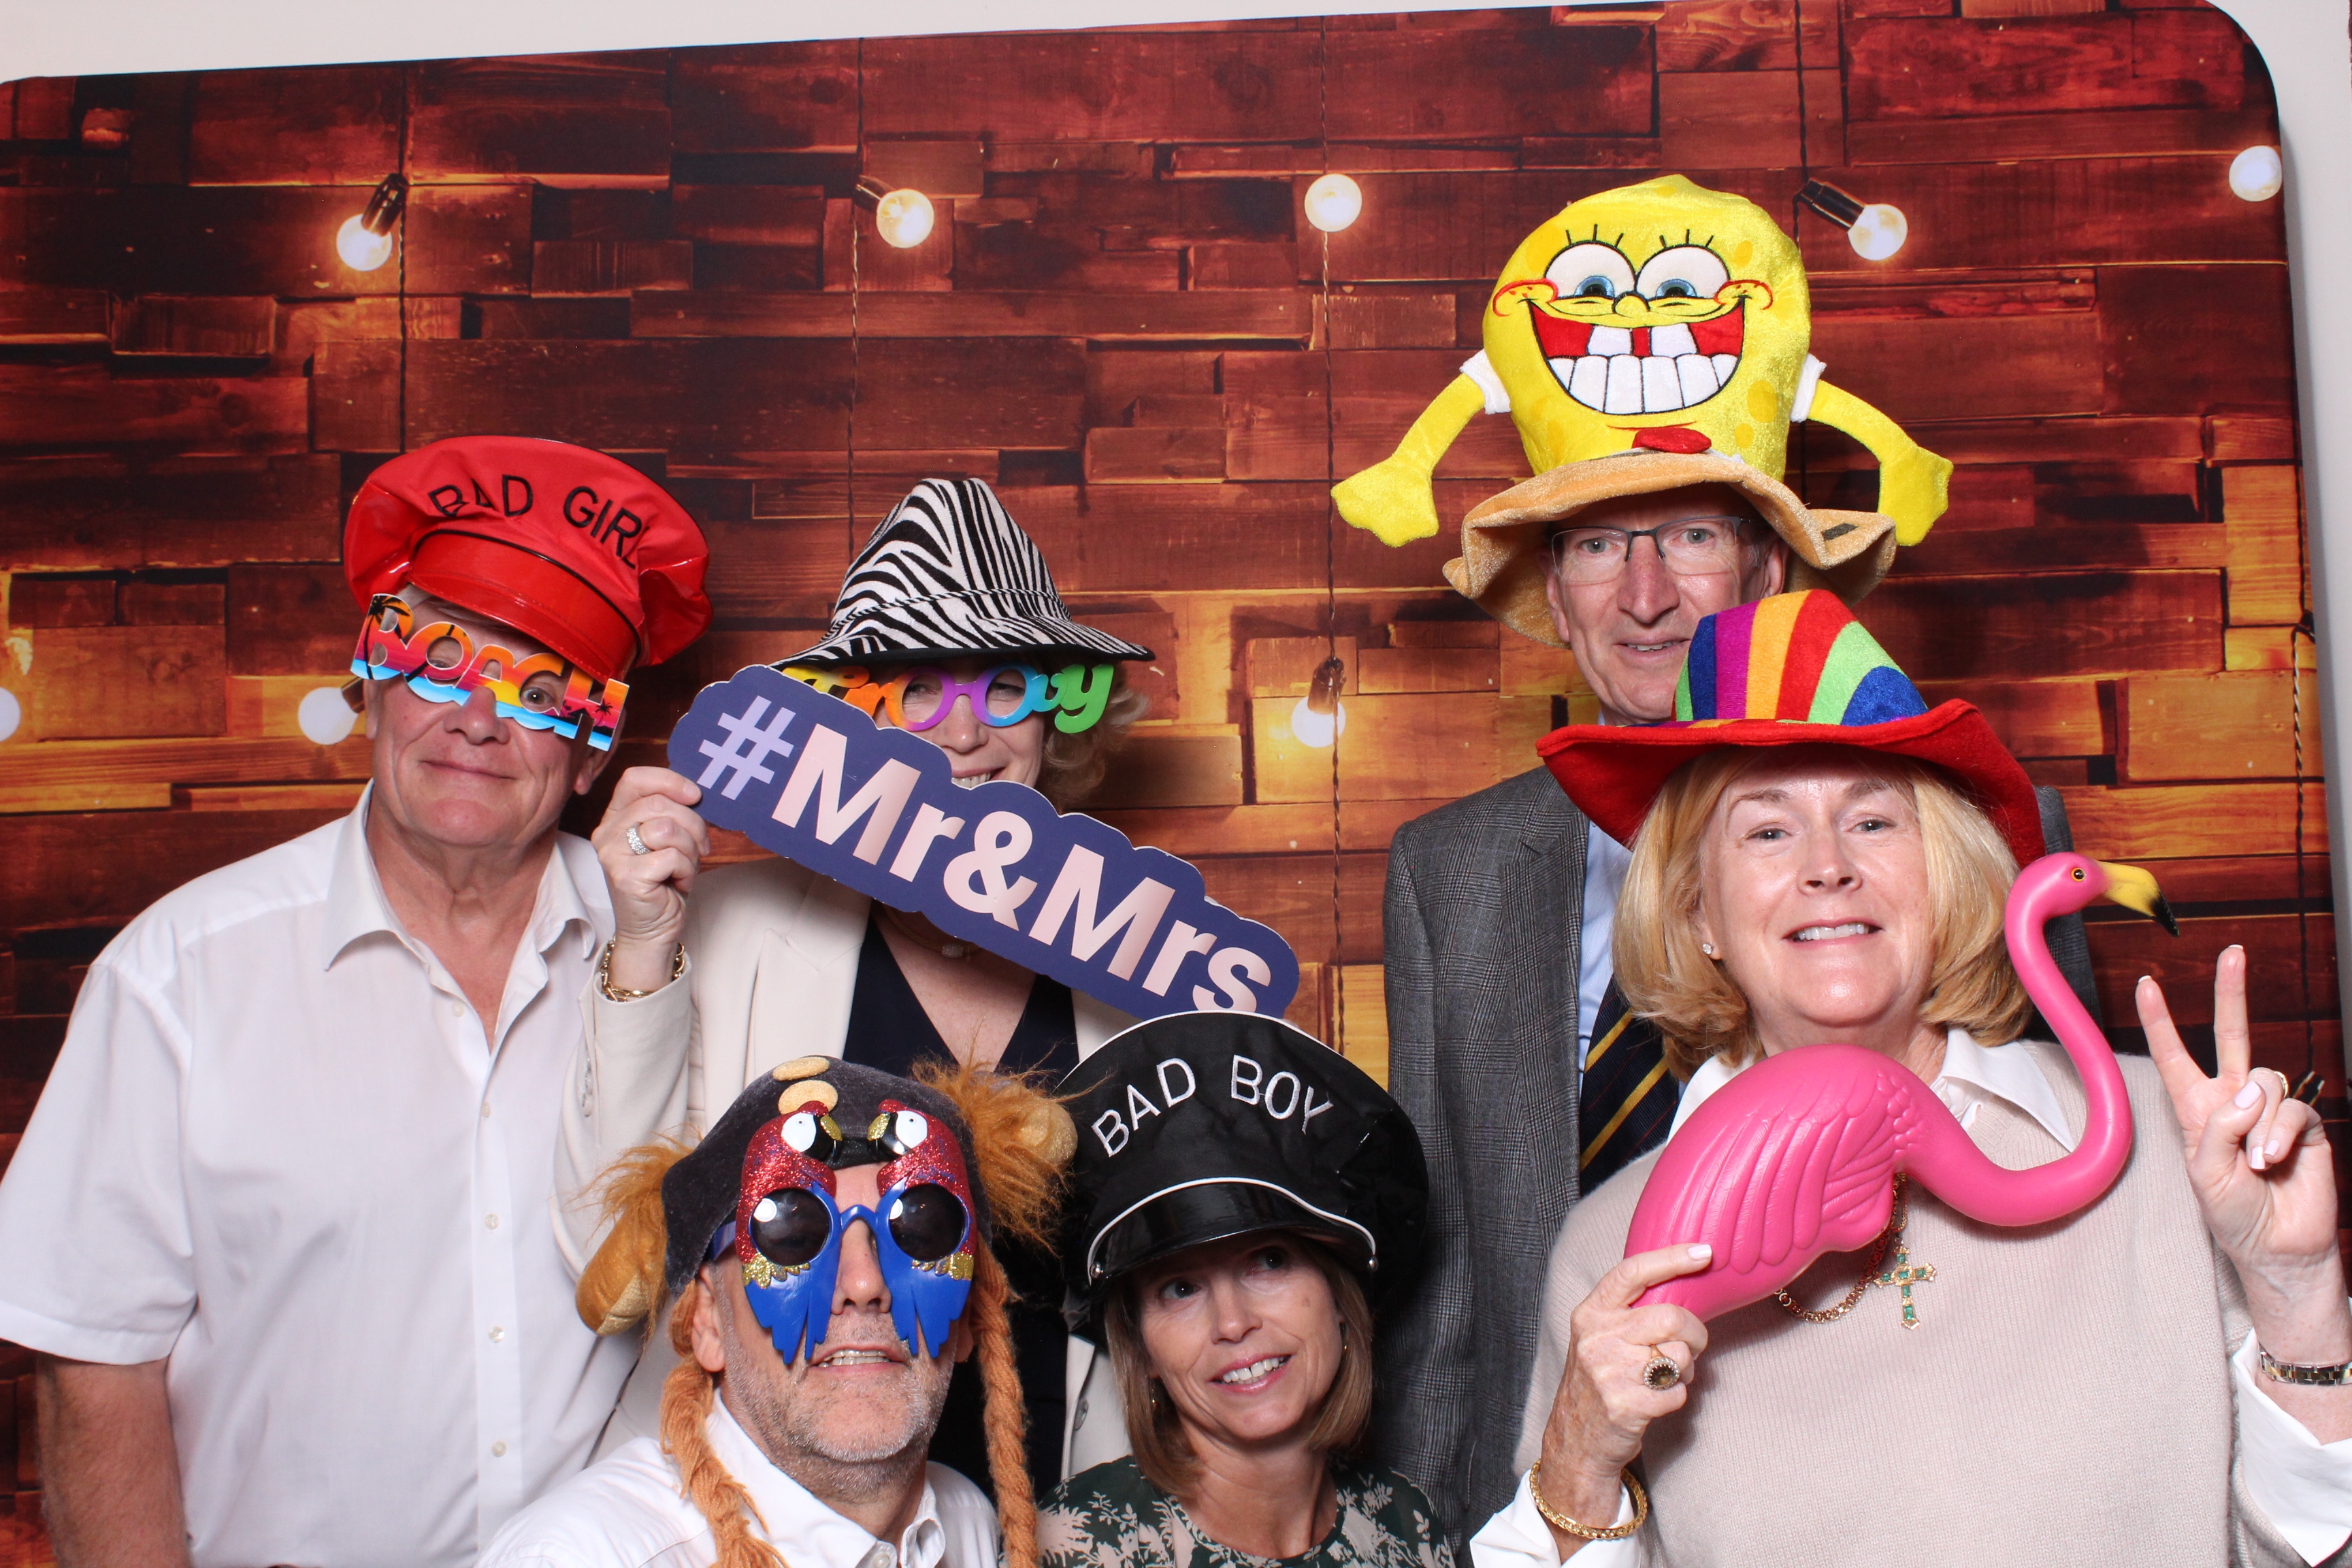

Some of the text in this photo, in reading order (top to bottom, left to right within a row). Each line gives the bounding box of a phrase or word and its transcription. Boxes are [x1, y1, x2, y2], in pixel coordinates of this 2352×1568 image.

[428, 474, 534, 517] BAD
[696, 695, 1271, 1013] #Mr&Mrs
[1091, 1054, 1335, 1158] BAD BOY
